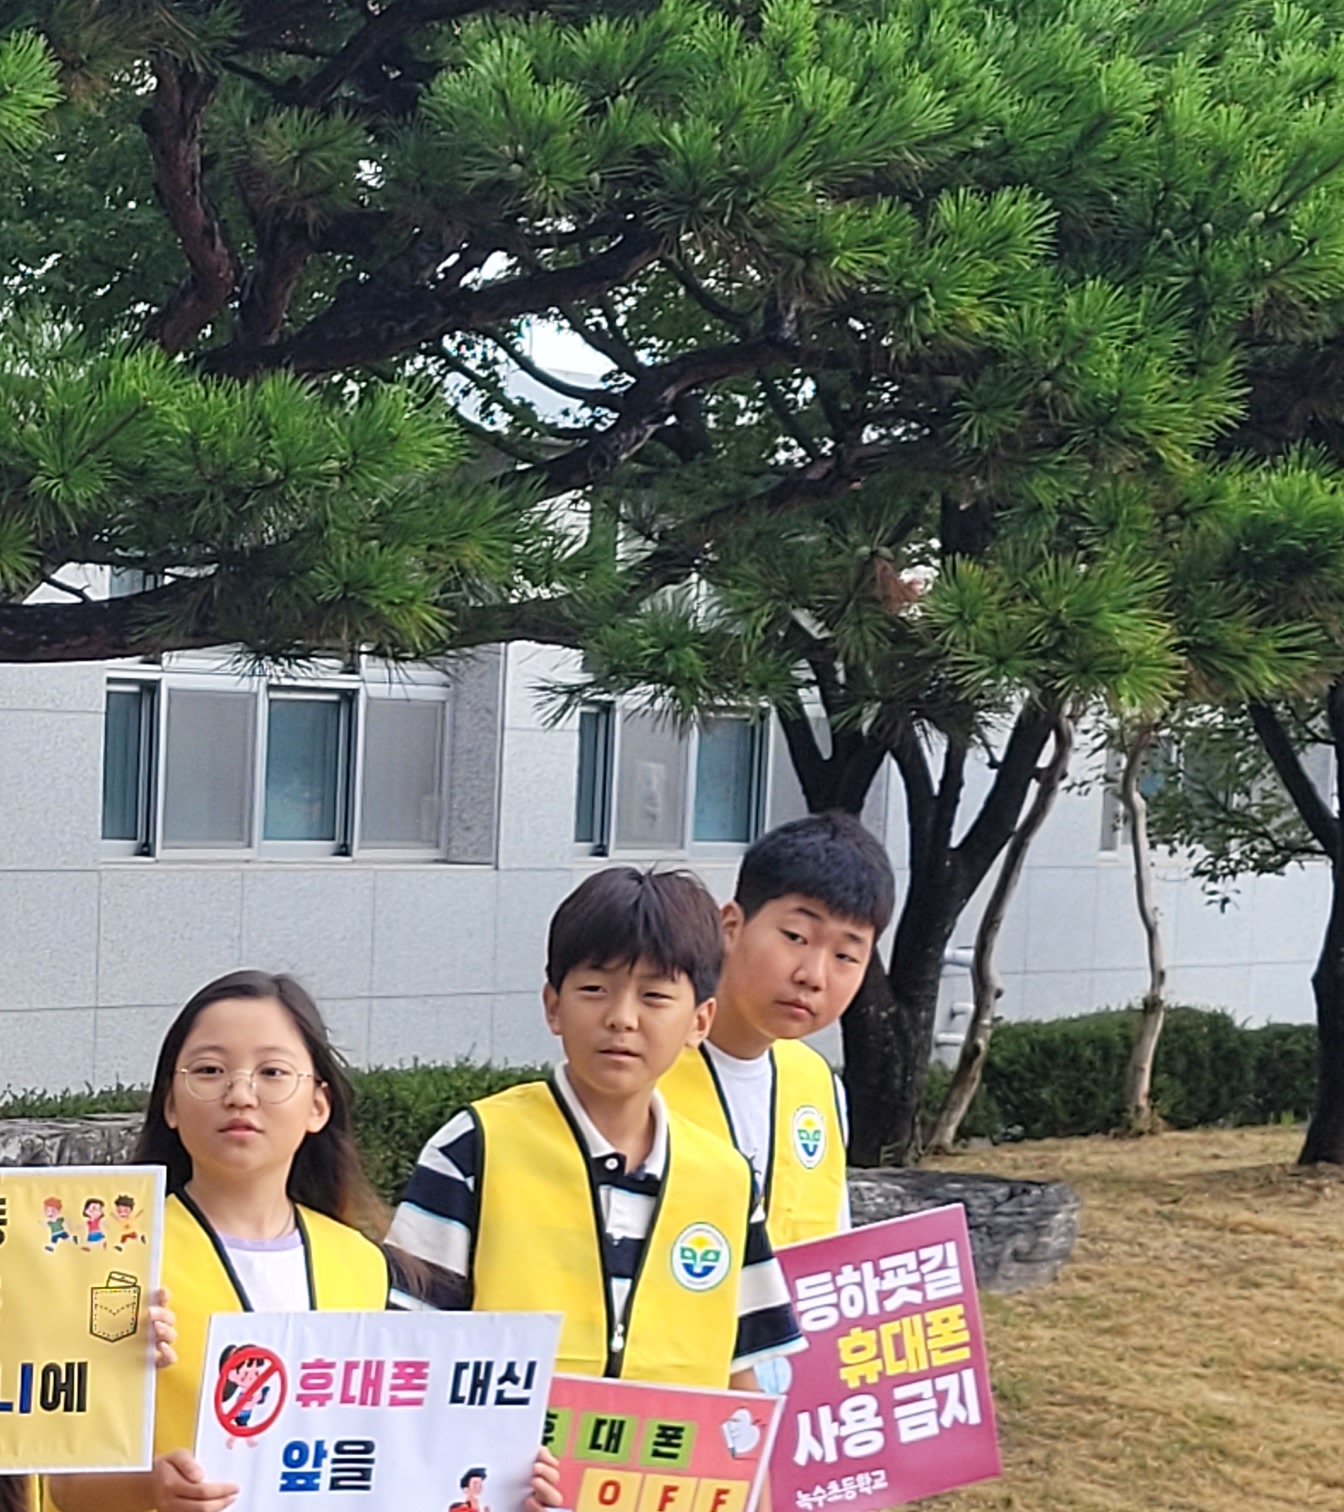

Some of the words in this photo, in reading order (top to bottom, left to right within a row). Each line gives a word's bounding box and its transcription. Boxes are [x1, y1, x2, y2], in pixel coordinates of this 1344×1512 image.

[794, 1240, 964, 1332] 등하굣길
[837, 1303, 971, 1389] 휴대폰
[295, 1358, 430, 1408] 휴대폰
[448, 1359, 538, 1407] 대신
[793, 1394, 885, 1467] 사용
[892, 1367, 982, 1443] 금지
[278, 1438, 376, 1492] 앞을
[795, 1469, 889, 1511] 녹수초등학교
